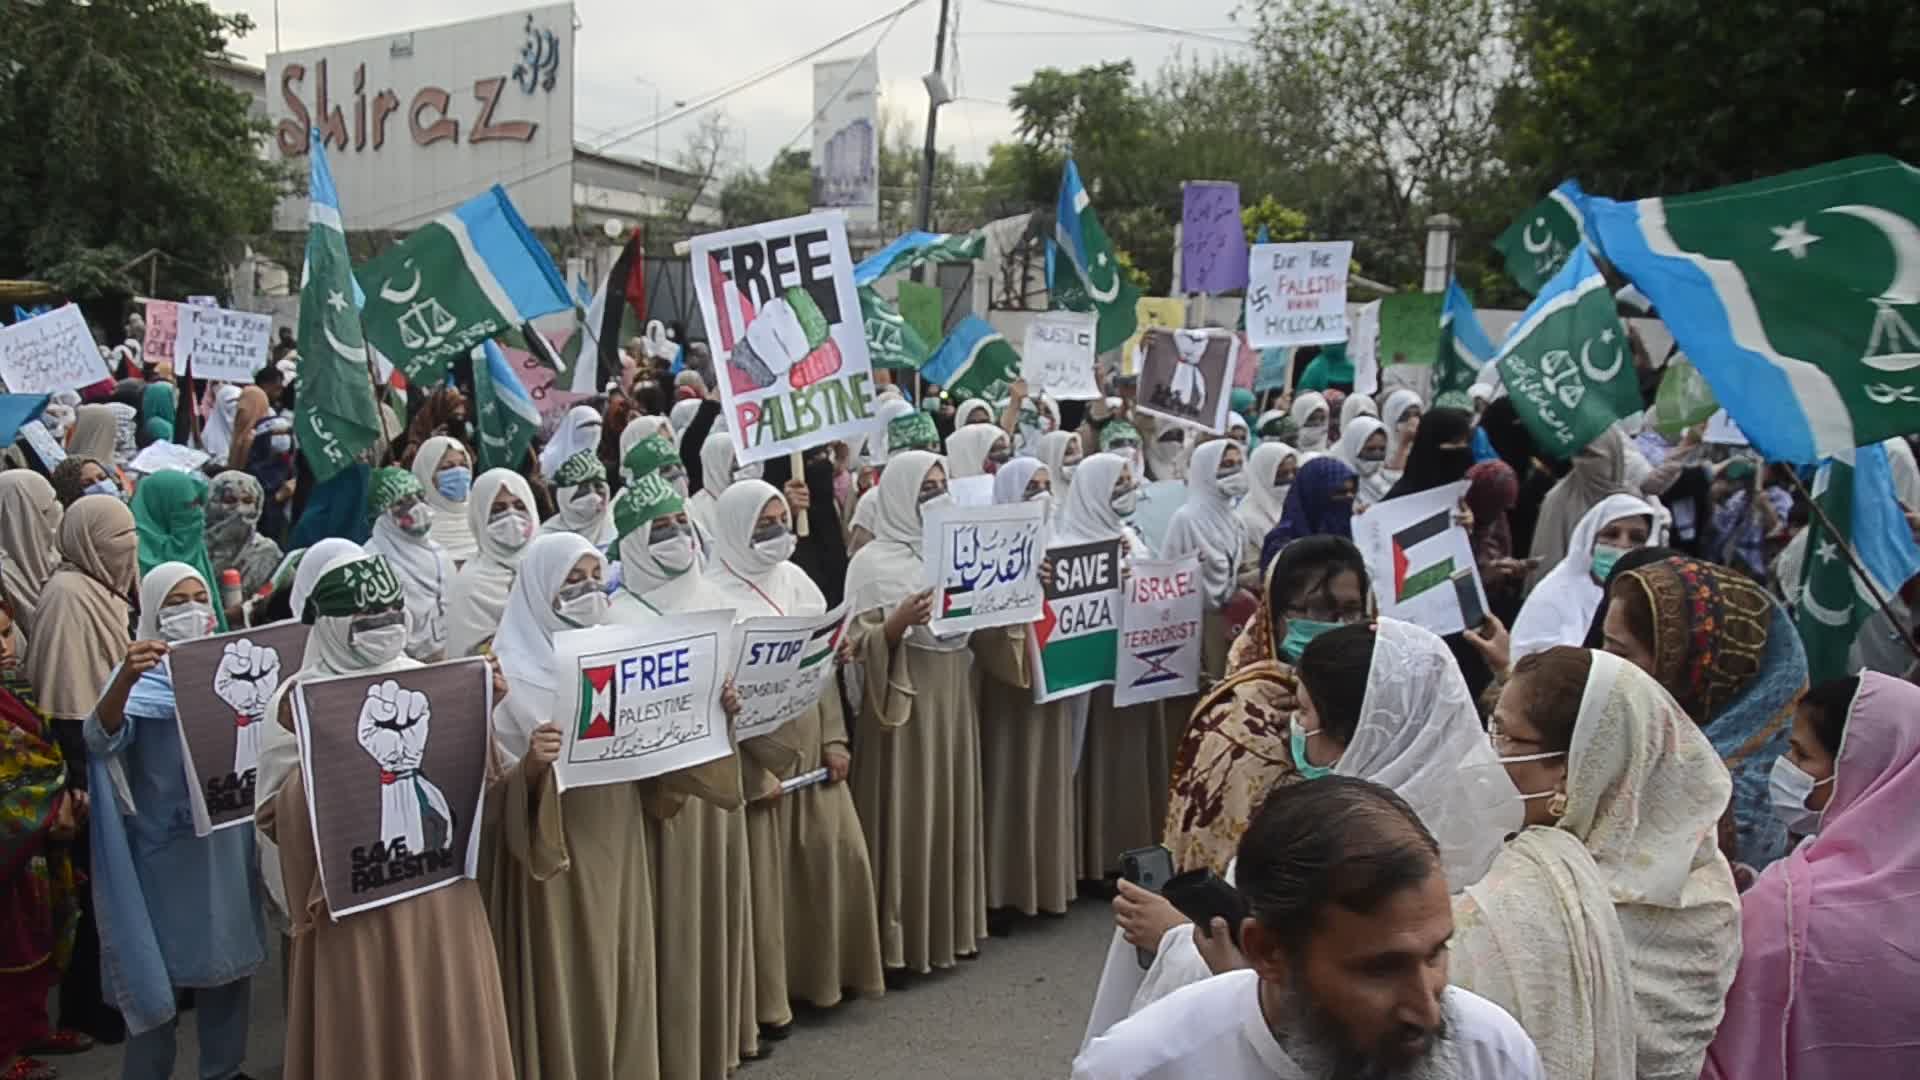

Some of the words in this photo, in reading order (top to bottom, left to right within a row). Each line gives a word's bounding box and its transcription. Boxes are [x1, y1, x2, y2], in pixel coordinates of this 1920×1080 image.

[277, 58, 538, 156] Shiraz
[707, 229, 843, 352] FREE
[1055, 552, 1110, 592] SAVE
[1131, 572, 1197, 604] ISRAEL
[1059, 596, 1113, 635] GAZA
[1123, 621, 1198, 649] TERRORIST
[620, 648, 690, 695] FREE
[746, 639, 804, 666] STOP
[619, 694, 693, 726] PALESTINE
[351, 835, 407, 872] SAVE
[351, 848, 452, 894] PALESTINE
